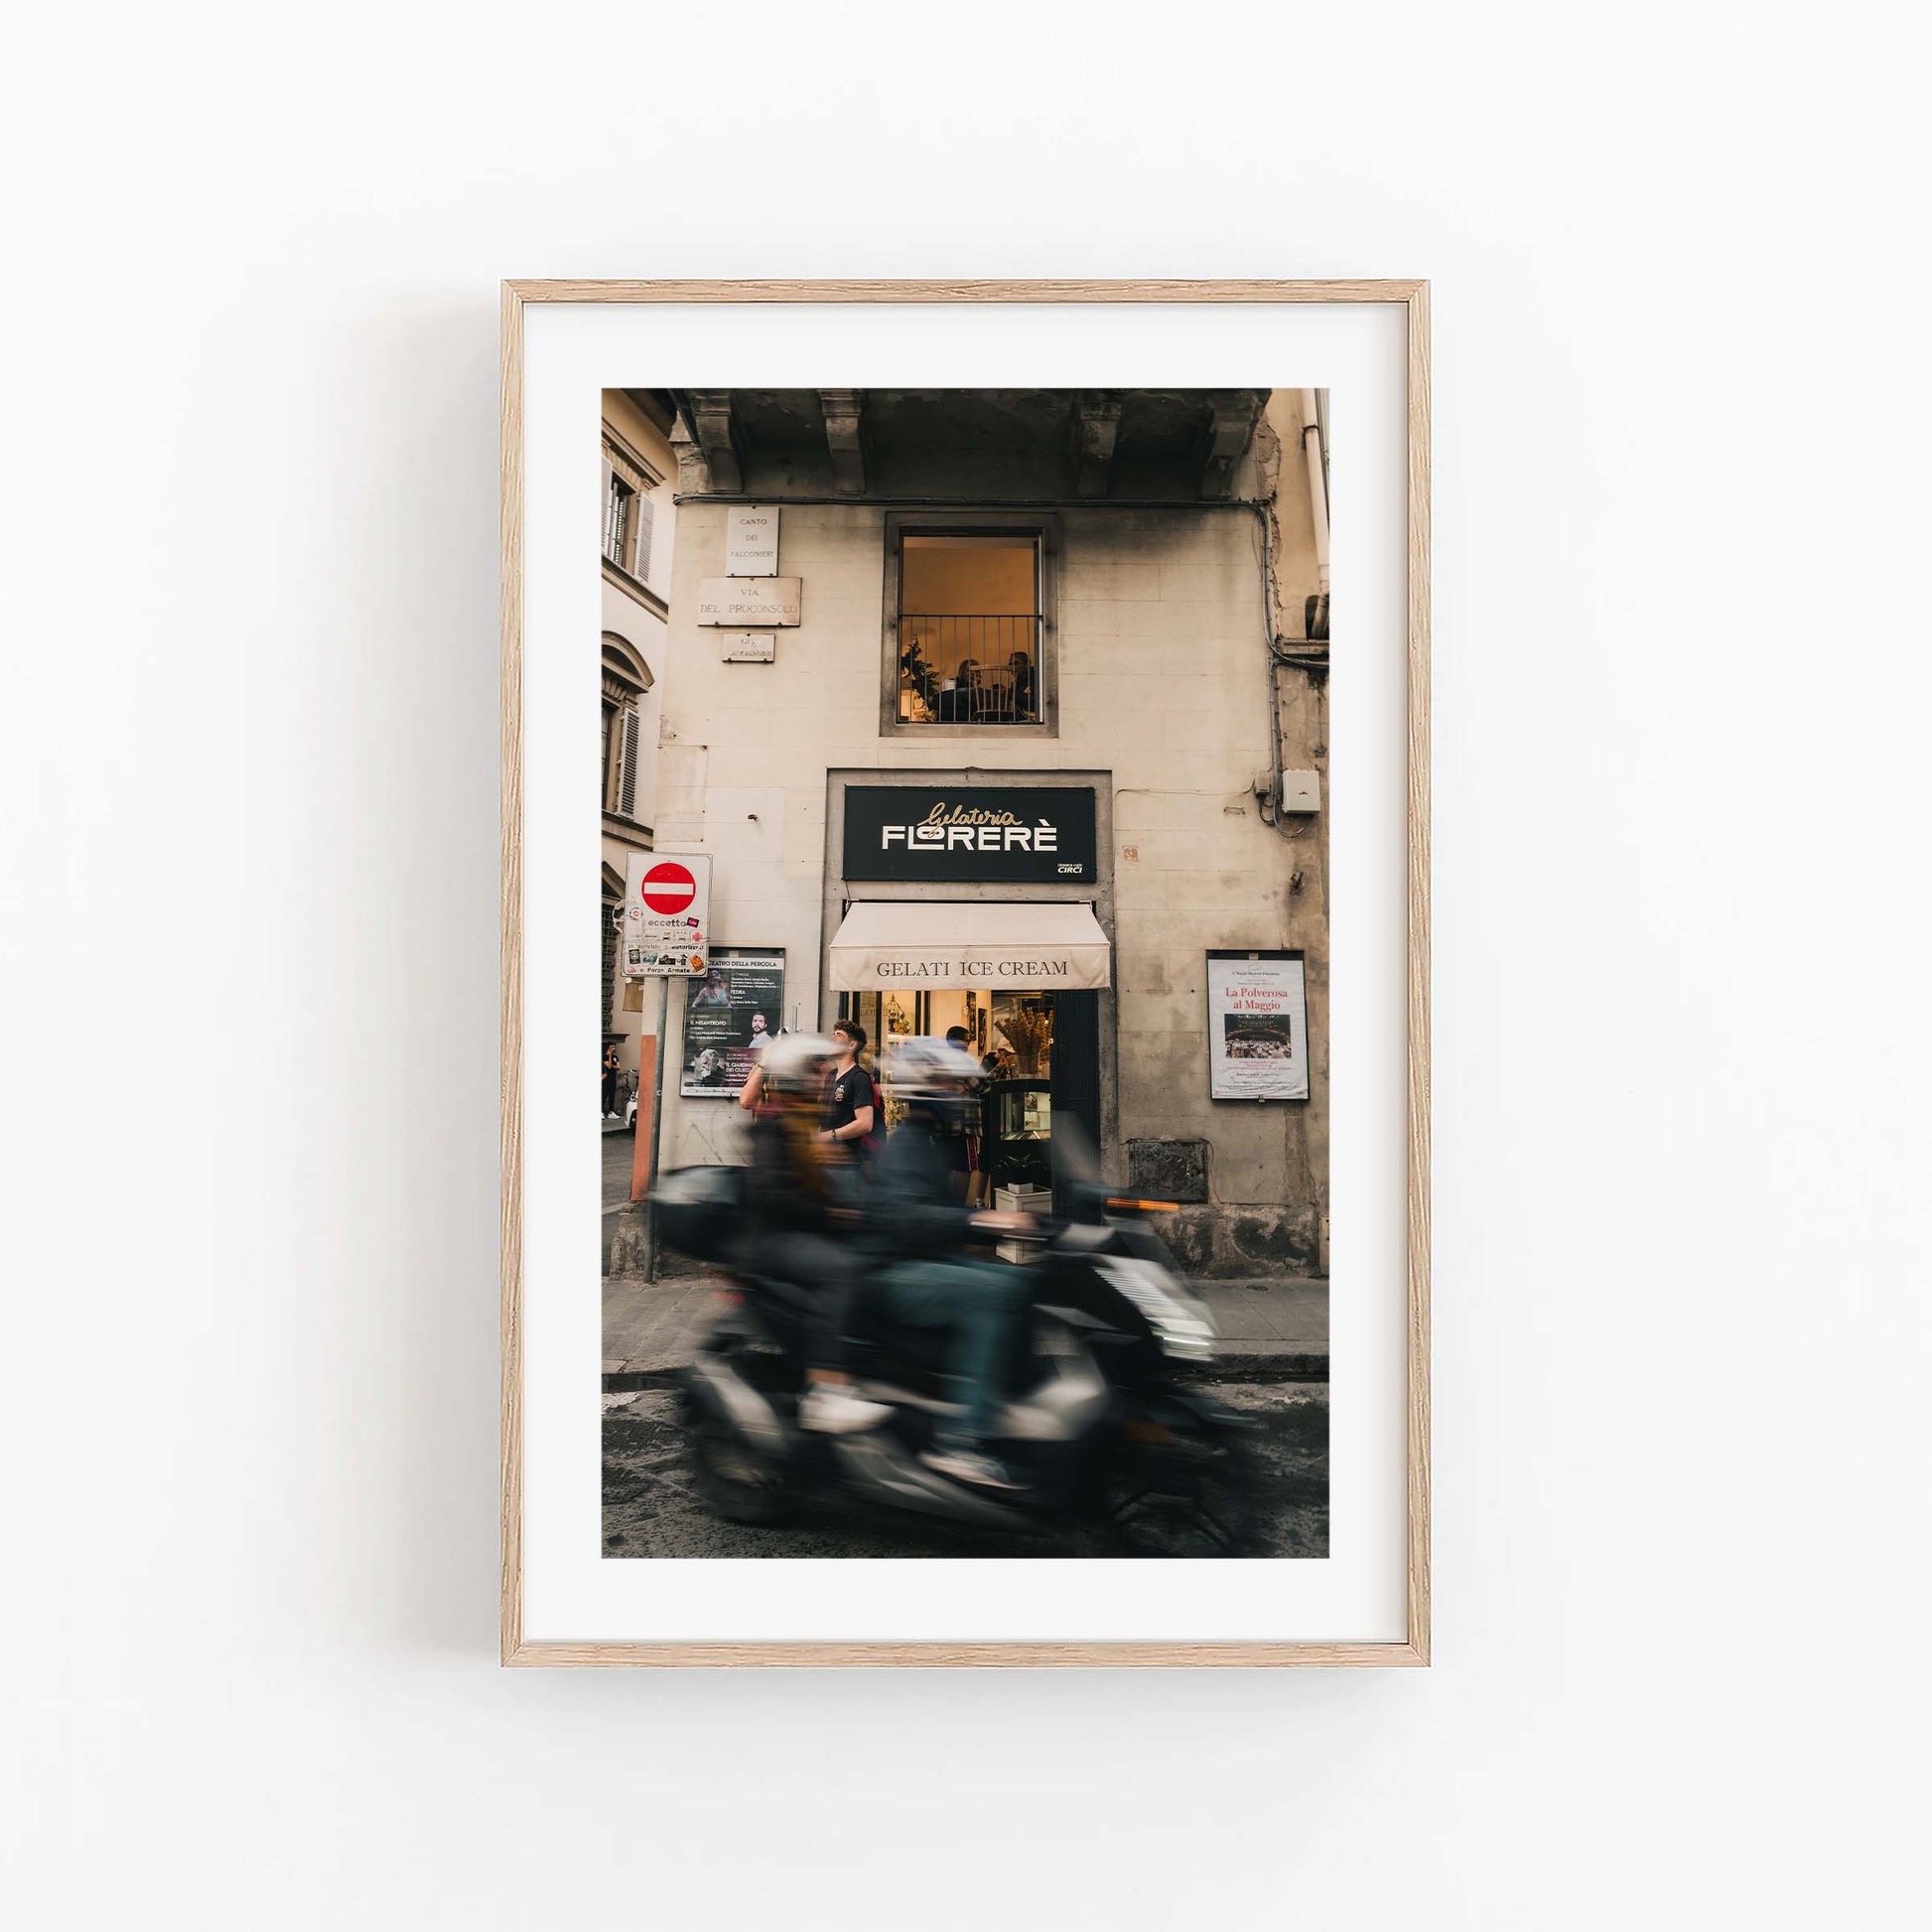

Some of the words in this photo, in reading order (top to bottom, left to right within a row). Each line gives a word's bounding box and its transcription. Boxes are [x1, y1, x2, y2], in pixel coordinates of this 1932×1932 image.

[741, 588, 759, 597] VIA
[700, 604, 721, 614] DEL
[729, 604, 798, 614] PROCONSOLO
[917, 801, 1023, 838] Gelateria
[647, 918, 687, 927] eccetto
[877, 962, 950, 977] GELATI
[960, 961, 993, 976] ICE
[998, 961, 1069, 976] CREAM
[1225, 987, 1238, 998] La
[1240, 987, 1288, 998] Polverosa
[1233, 999, 1242, 1010] al
[1245, 999, 1281, 1013] Maggio
